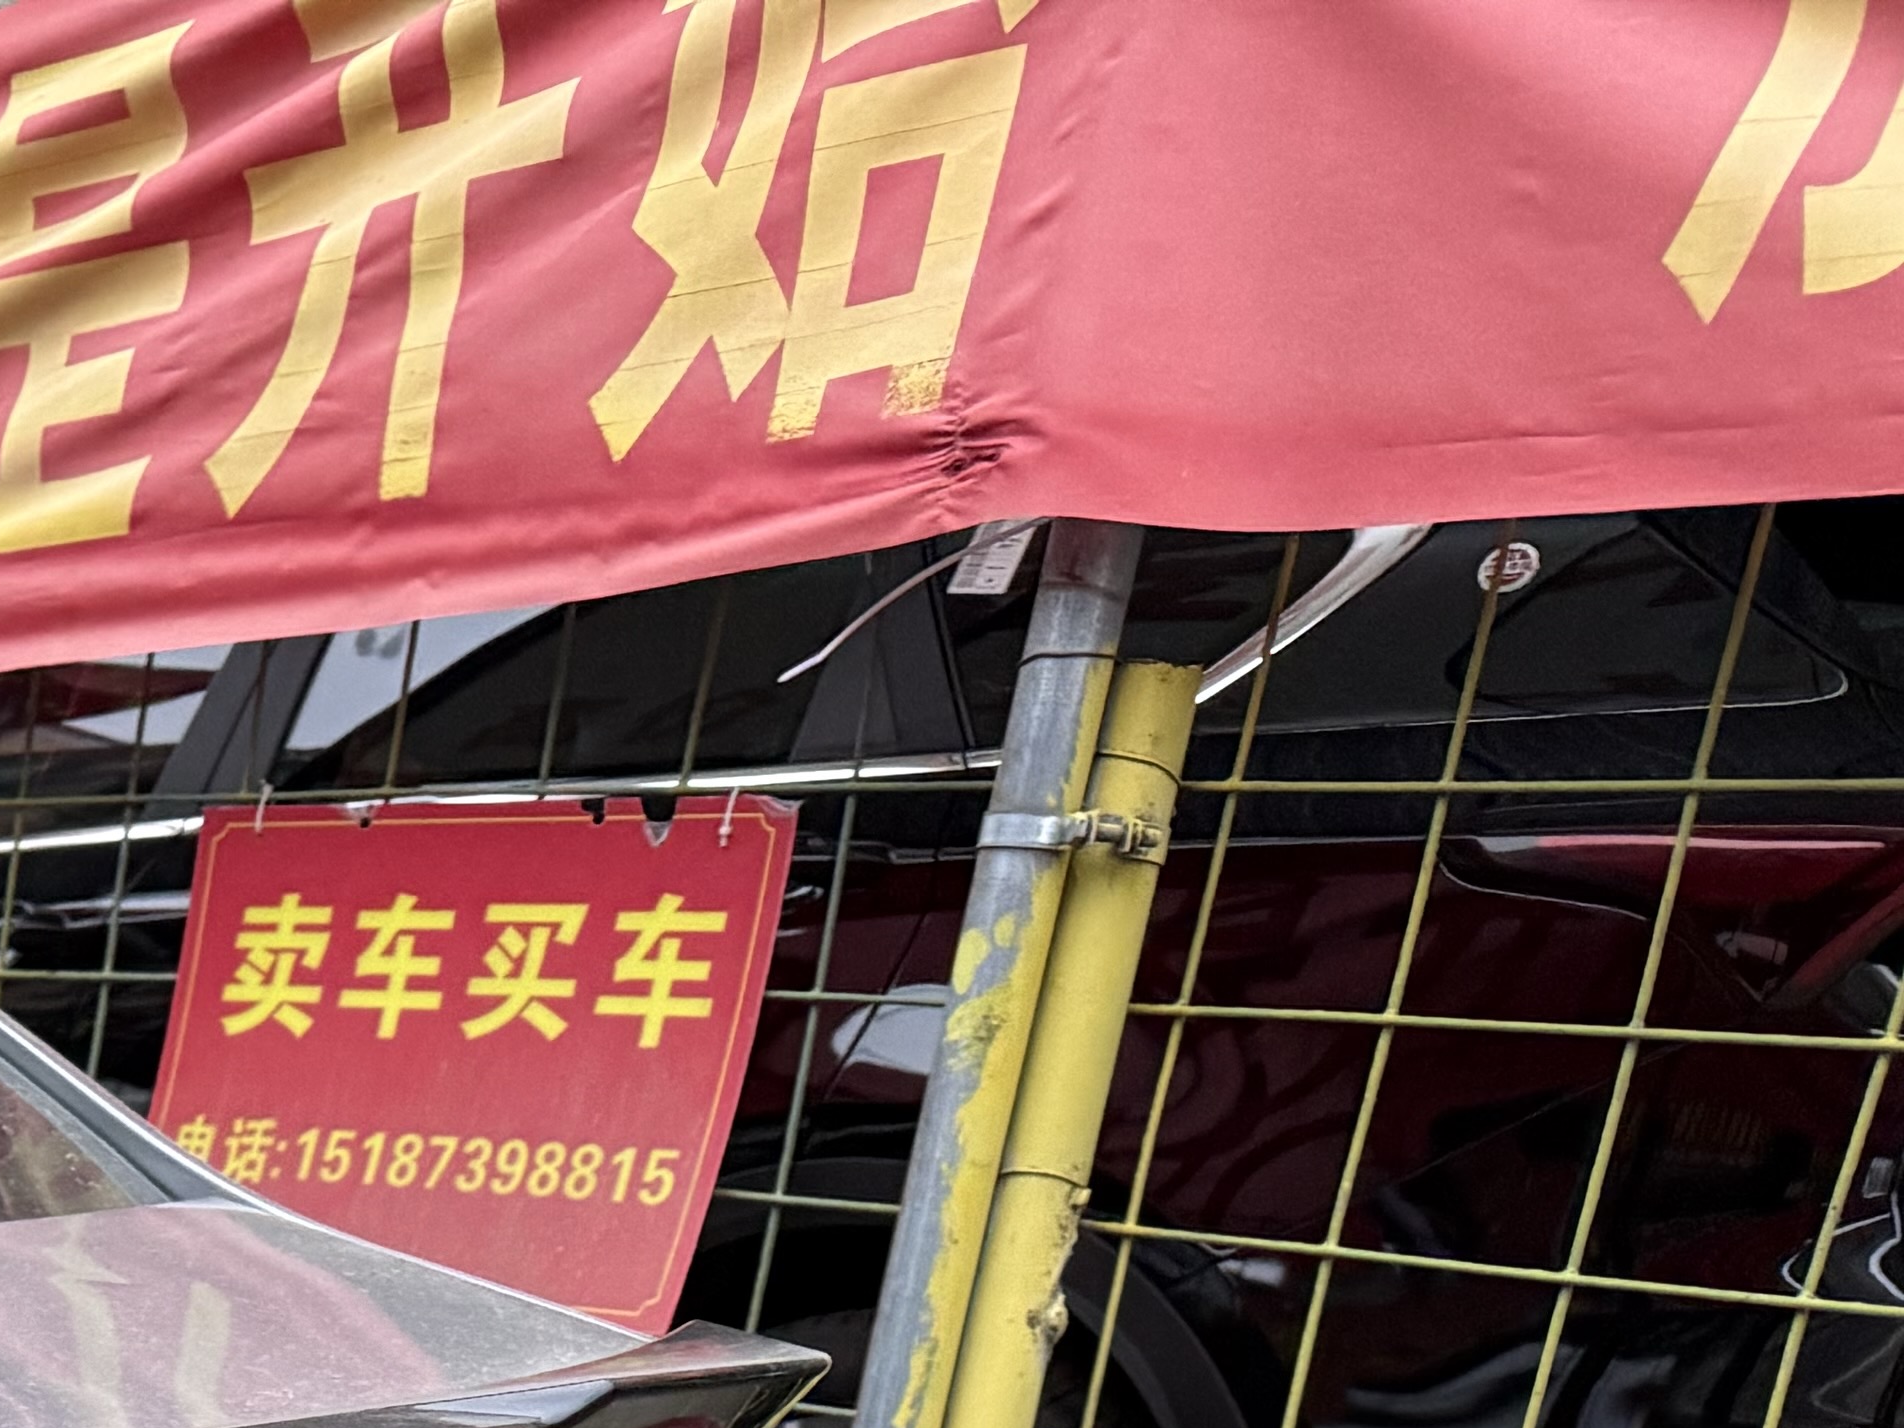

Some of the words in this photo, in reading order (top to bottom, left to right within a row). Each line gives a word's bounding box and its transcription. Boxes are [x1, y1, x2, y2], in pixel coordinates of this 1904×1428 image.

[219, 892, 729, 1049] 卖车买车
[174, 1114, 681, 1207] 电话:15187398815
